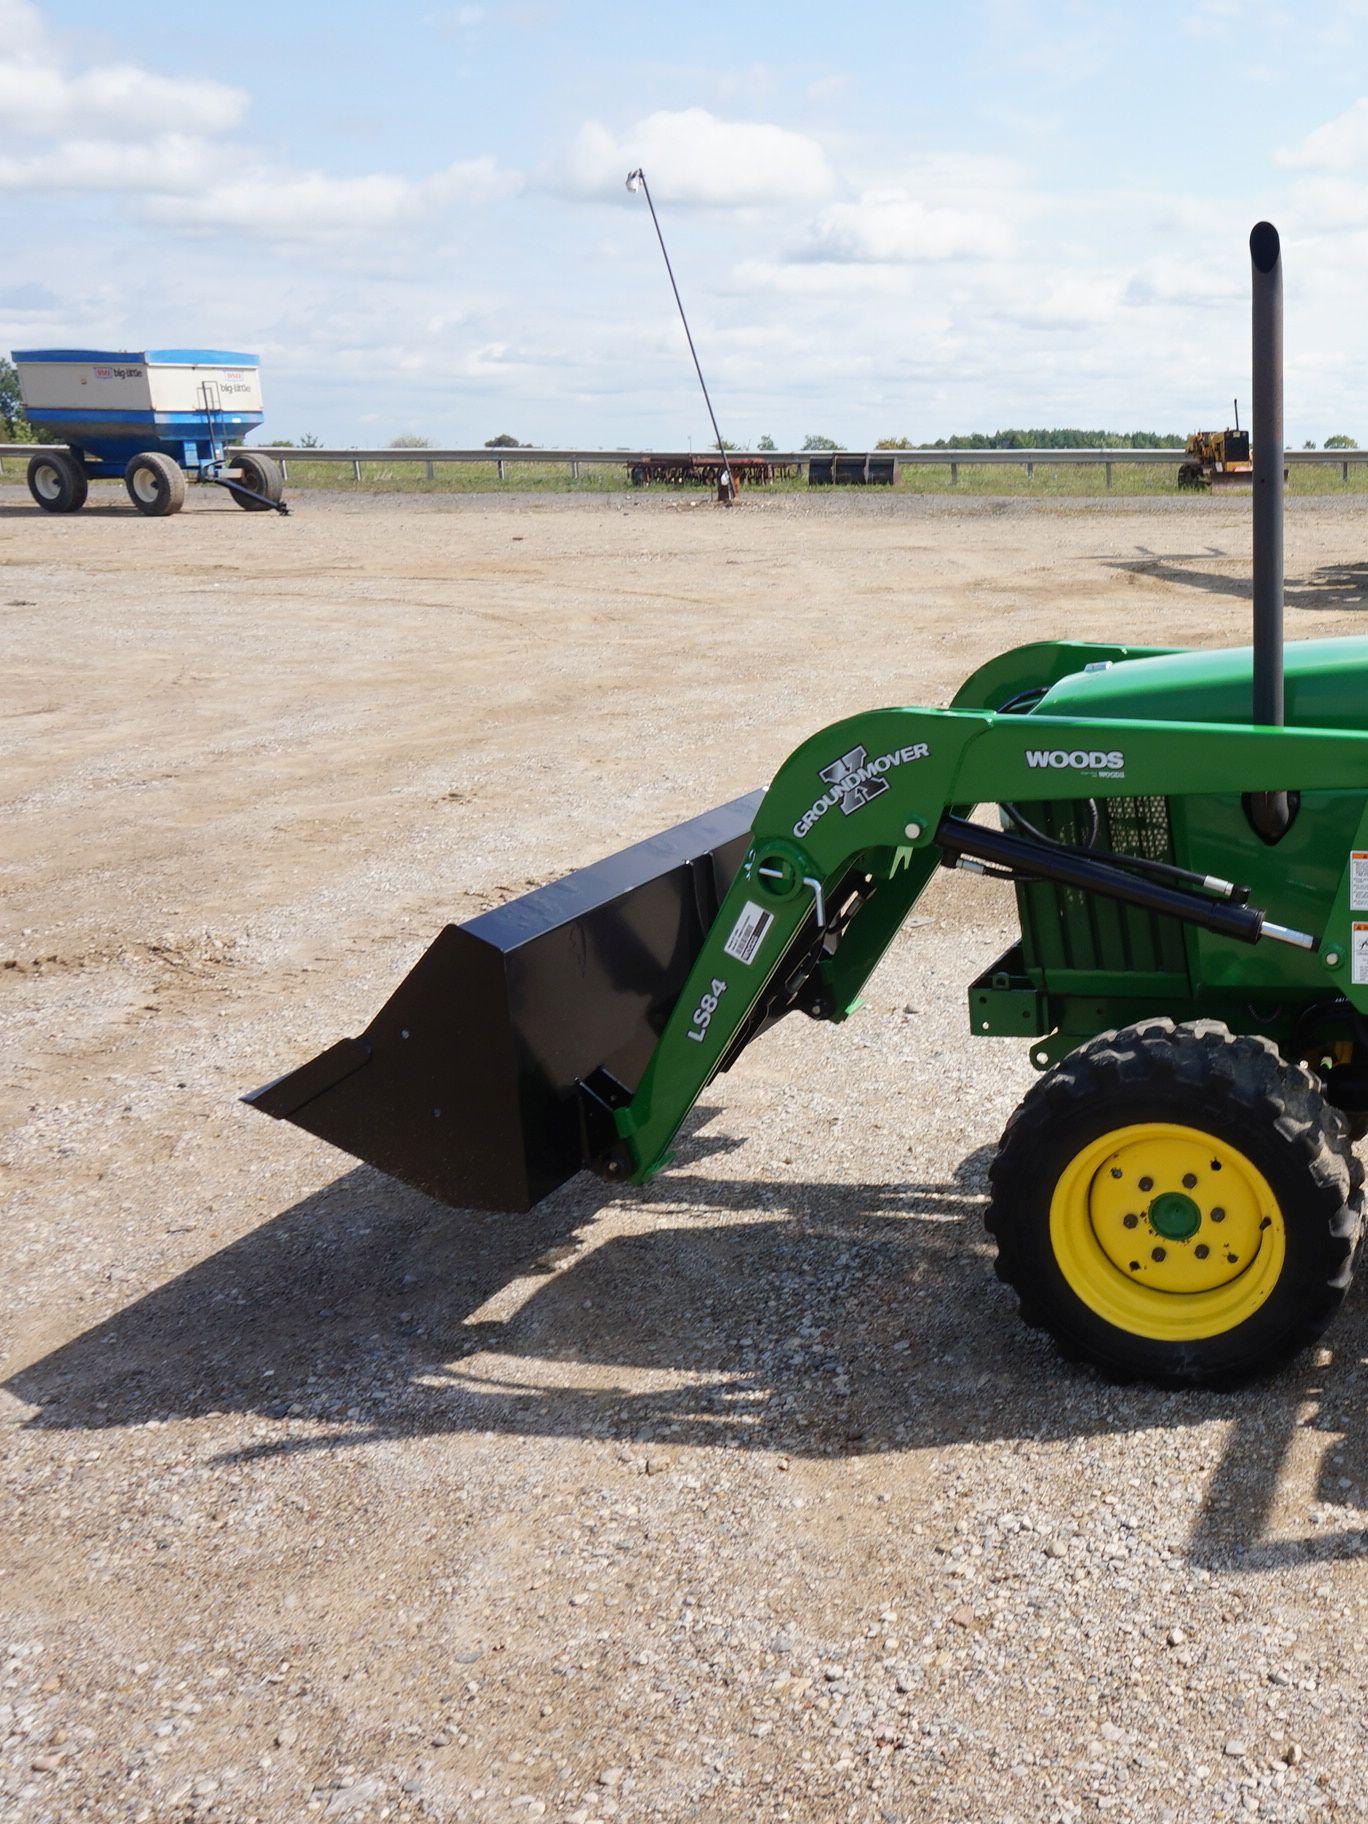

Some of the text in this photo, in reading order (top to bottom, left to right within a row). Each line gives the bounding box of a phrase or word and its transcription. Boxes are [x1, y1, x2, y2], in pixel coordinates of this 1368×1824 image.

[793, 743, 930, 838] GROUNDMOVER
[1025, 750, 1125, 769] WOODS
[687, 978, 727, 1042] LS84
